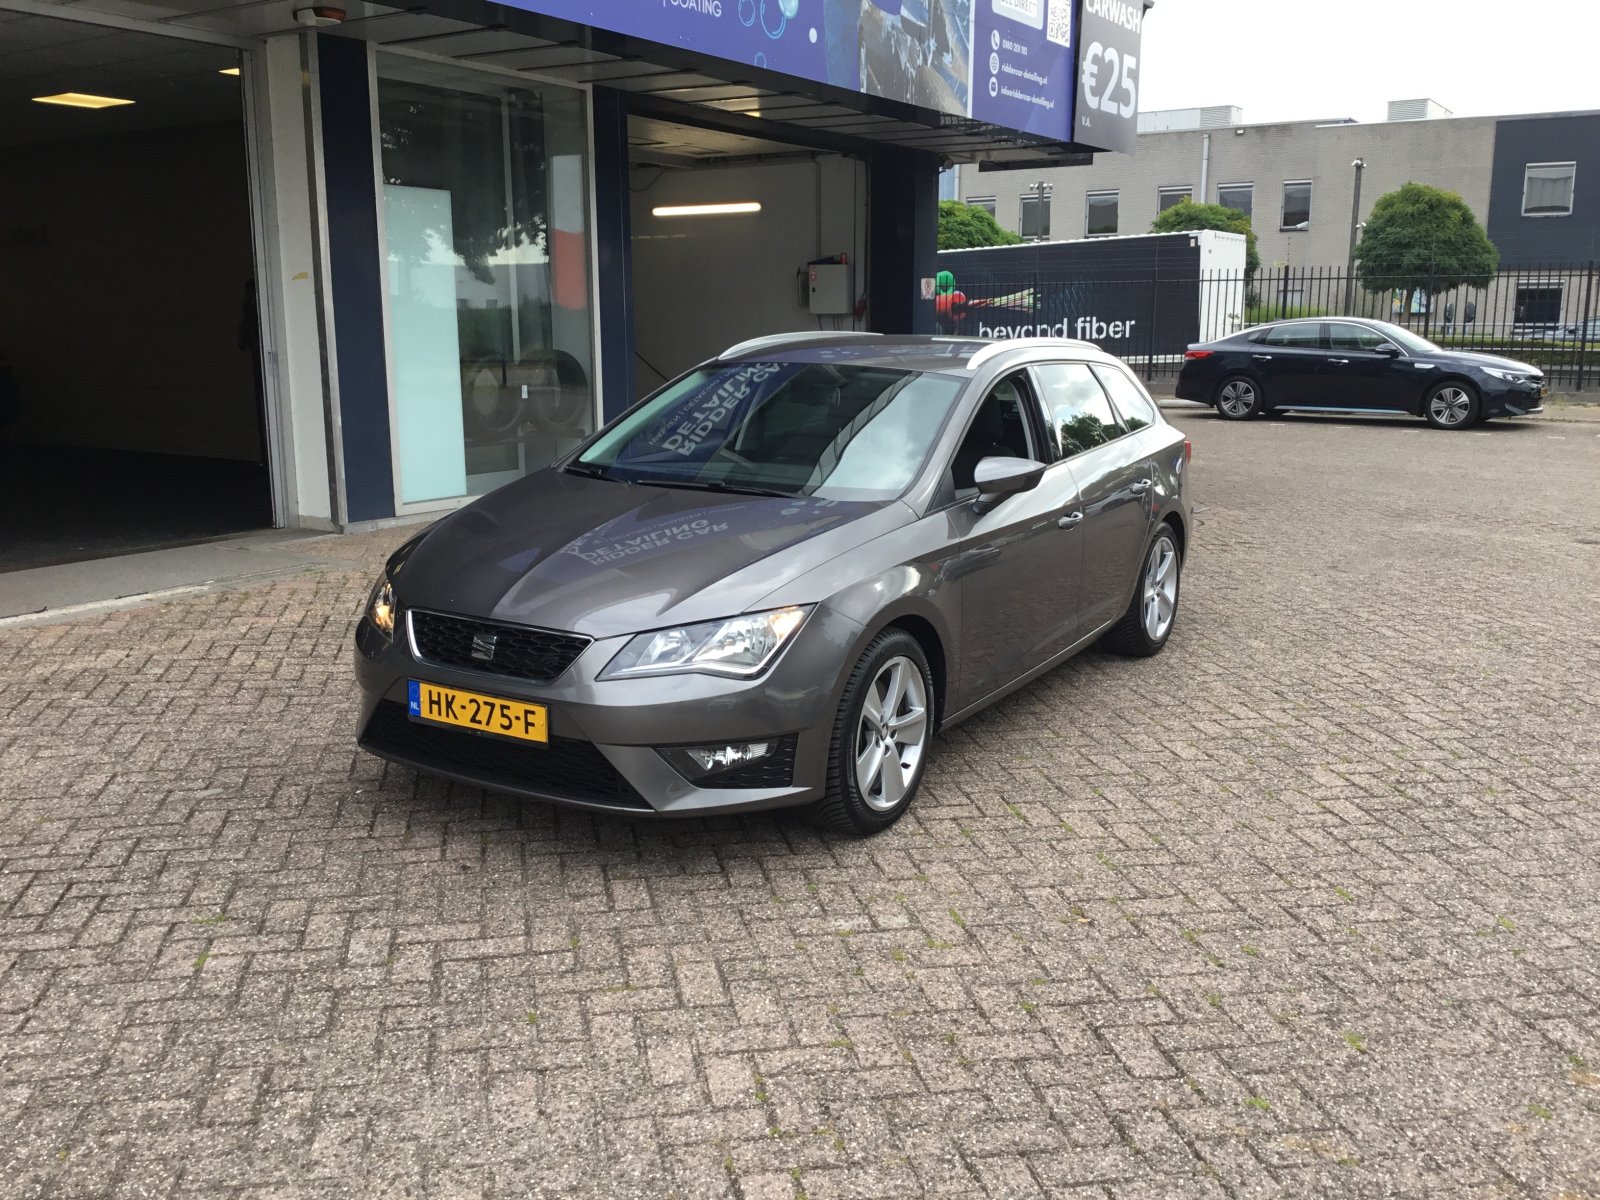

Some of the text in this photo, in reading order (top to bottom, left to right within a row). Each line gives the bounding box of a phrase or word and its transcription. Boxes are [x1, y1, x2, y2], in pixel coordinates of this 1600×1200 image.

[1081, 41, 1136, 119] €25
[1074, 316, 1136, 340] fiber
[410, 700, 420, 711] NL
[428, 689, 536, 735] HK-275-F
